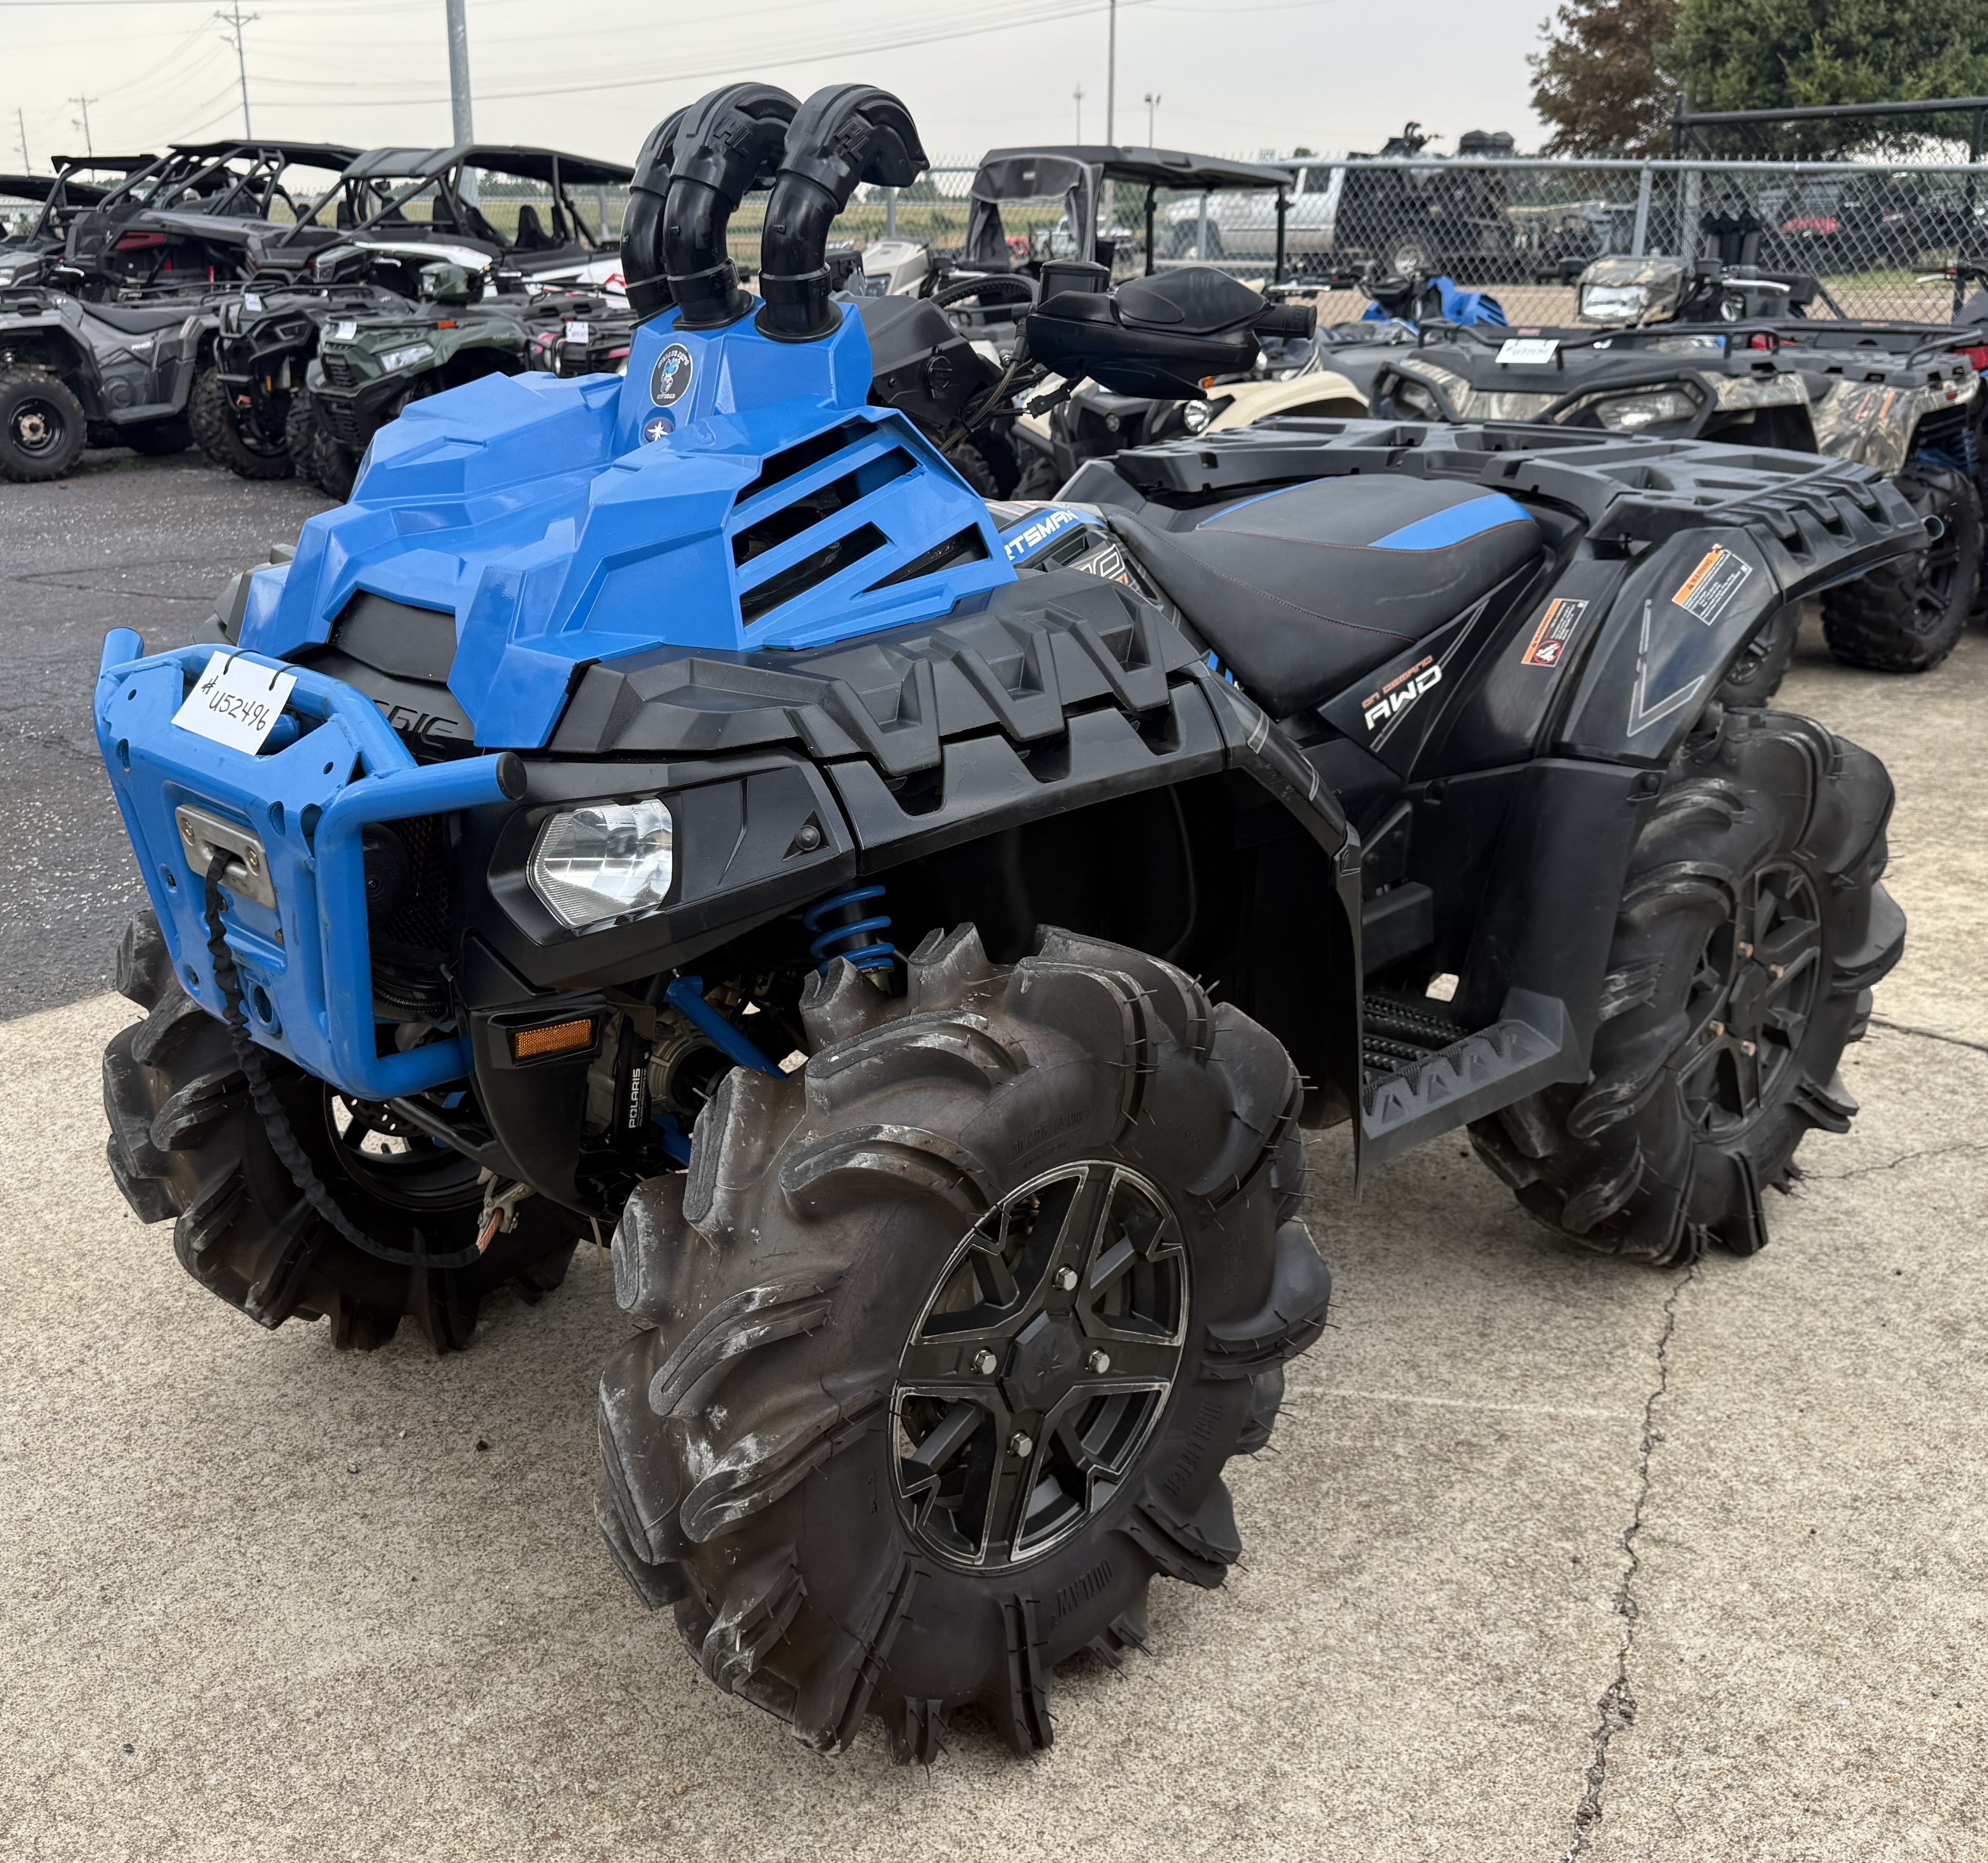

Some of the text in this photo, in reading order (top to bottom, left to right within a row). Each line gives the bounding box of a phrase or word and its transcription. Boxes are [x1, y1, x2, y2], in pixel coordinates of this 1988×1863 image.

[1692, 558, 1713, 585] WARNING
[1364, 665, 1443, 731] AWD
[628, 1068, 641, 1128] POLARIS
[1056, 1558, 1114, 1618] OUTLAW
